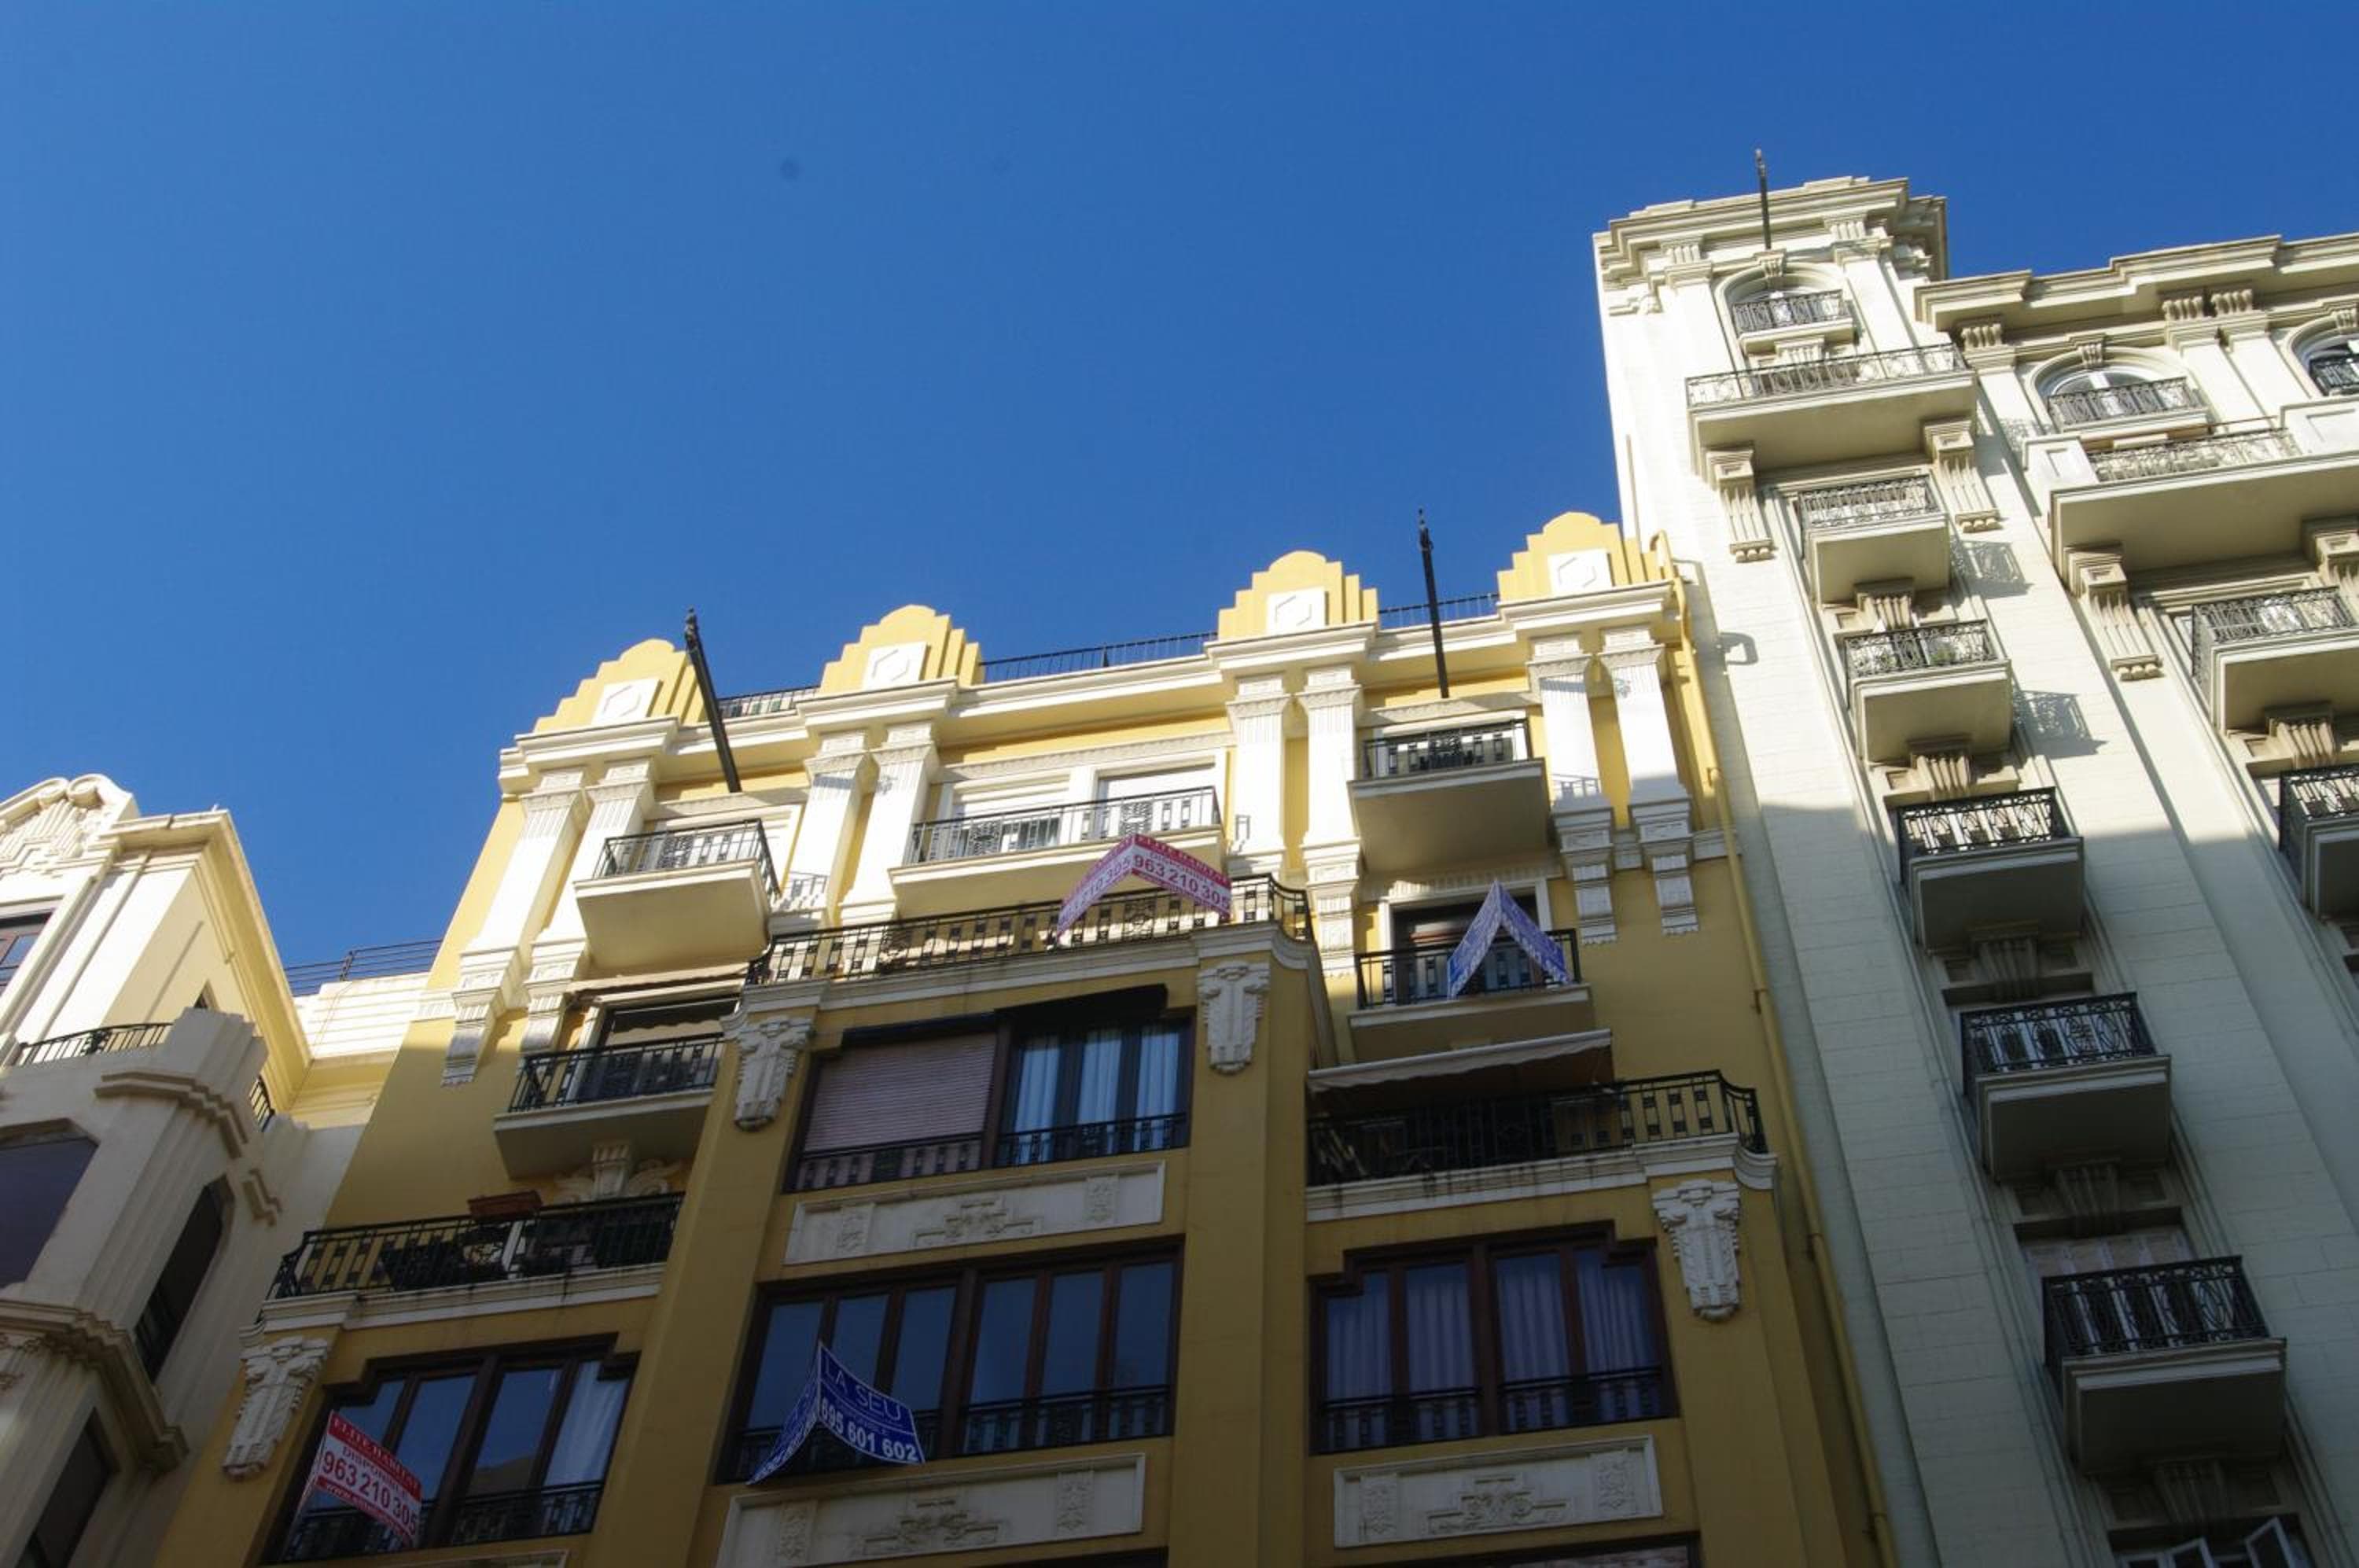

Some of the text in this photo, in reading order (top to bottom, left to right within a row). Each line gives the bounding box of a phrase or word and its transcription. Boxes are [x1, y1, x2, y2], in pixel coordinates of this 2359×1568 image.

[1132, 854, 1165, 877] 963
[1167, 868, 1199, 893] 210
[1202, 884, 1231, 910] 305
[826, 1353, 848, 1395] LA
[856, 1385, 902, 1421] SEU
[847, 1421, 876, 1453] 601
[881, 1437, 919, 1461] 602
[322, 1451, 358, 1486] 963
[359, 1472, 391, 1509] 210
[393, 1496, 417, 1535] 305
